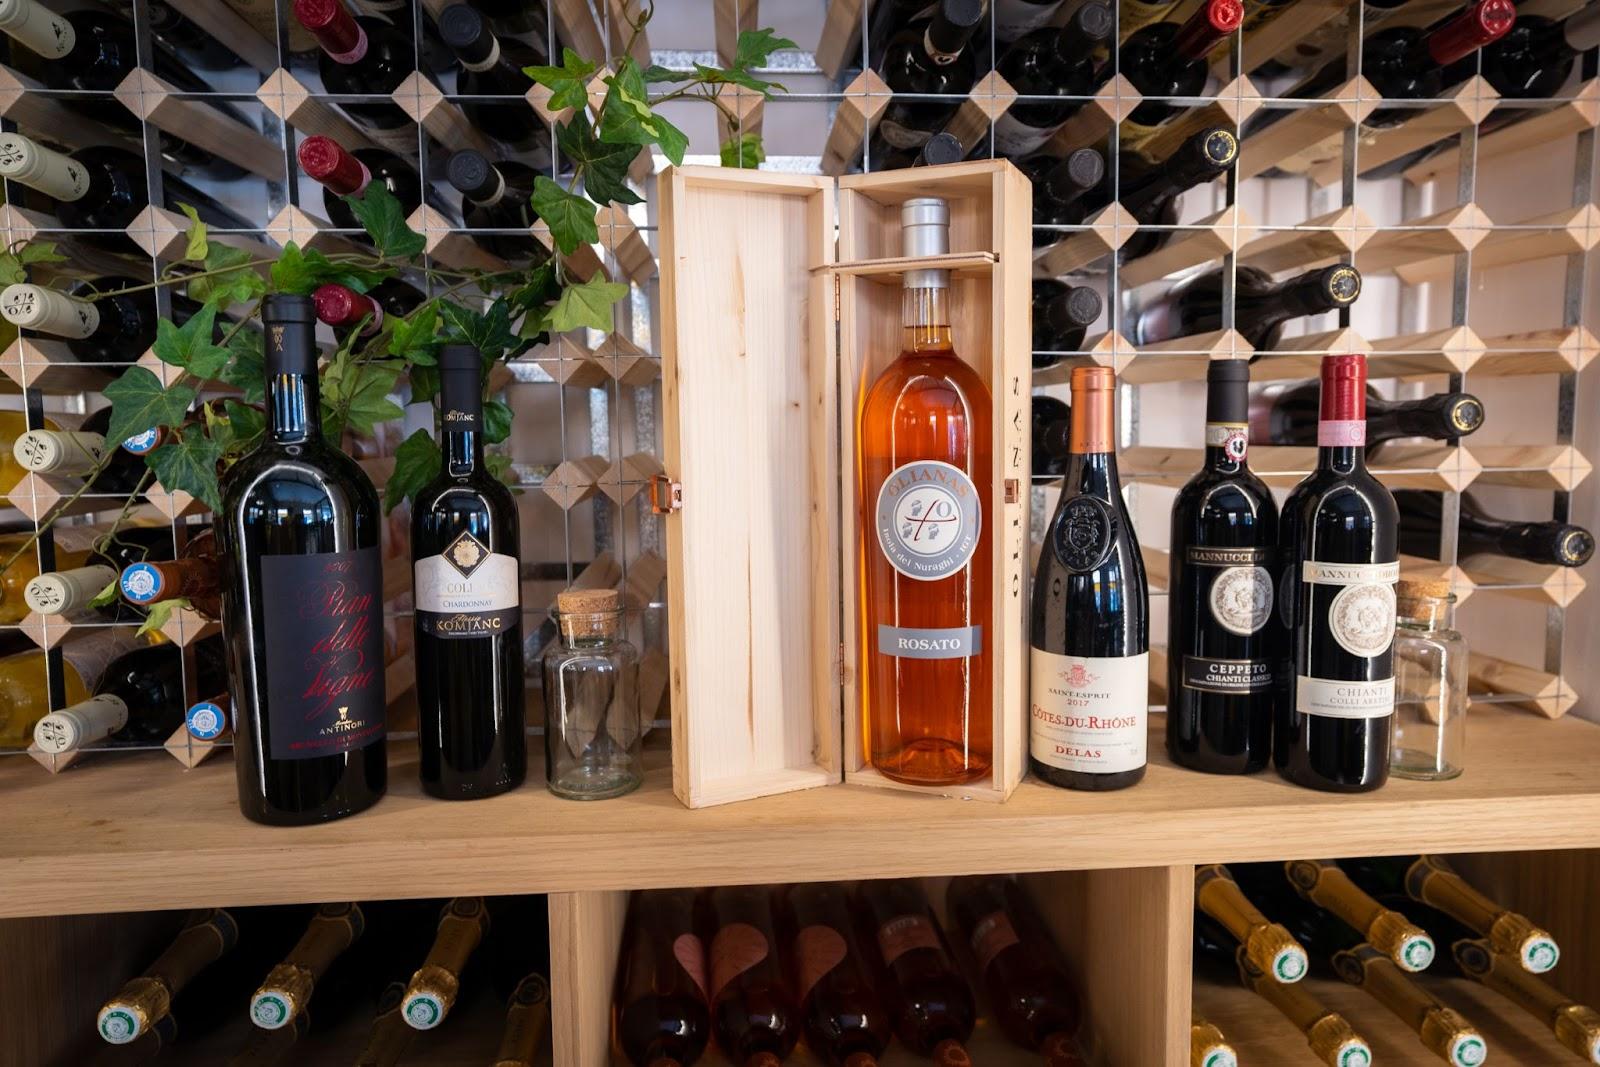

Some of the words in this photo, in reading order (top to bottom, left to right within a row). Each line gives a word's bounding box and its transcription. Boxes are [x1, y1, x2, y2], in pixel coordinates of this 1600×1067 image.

[888, 467, 969, 497] OLIANAS
[897, 552, 911, 566] dei
[914, 556, 954, 571] Nuraghi
[442, 600, 492, 608] CHARDONNAY
[436, 617, 501, 631] KOMJANC
[898, 638, 961, 650] ROSATO
[1209, 663, 1267, 675] CEPPETO
[1206, 674, 1242, 683] CHIANTI
[1067, 699, 1089, 707] 2017
[319, 720, 365, 735] ANTINORI
[1055, 745, 1102, 758] DELAS
